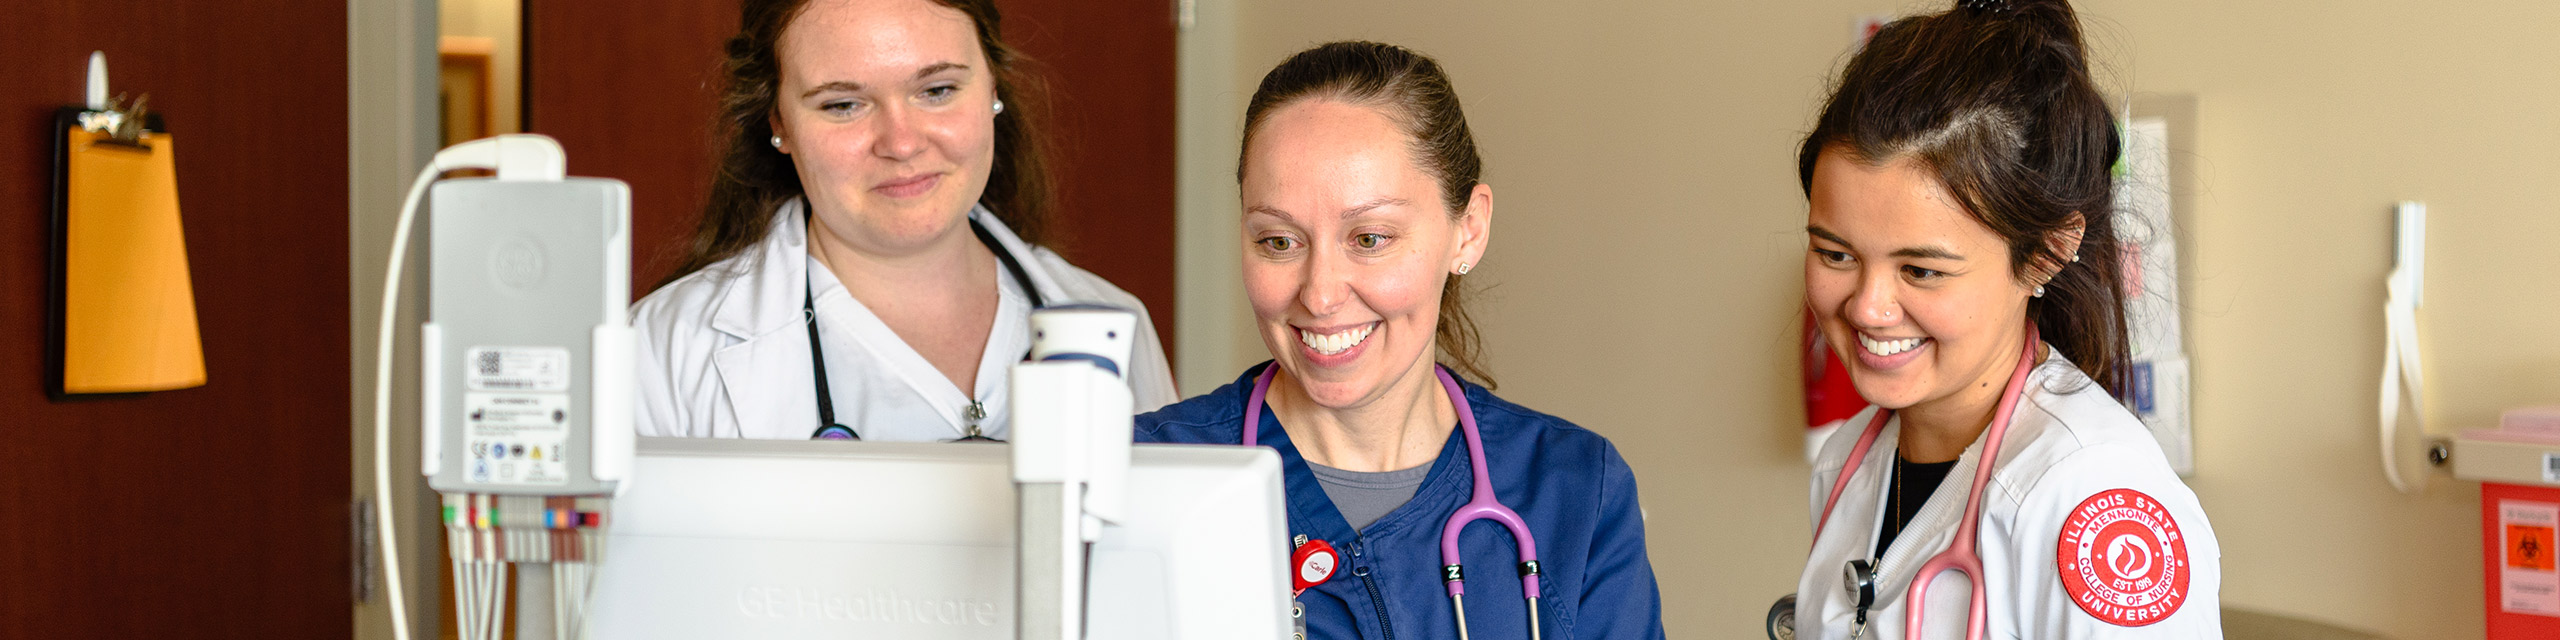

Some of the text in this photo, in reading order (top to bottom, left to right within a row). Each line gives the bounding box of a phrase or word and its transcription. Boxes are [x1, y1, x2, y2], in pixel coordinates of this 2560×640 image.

[2066, 493, 2178, 544] ILLINOIS STATE
[2089, 509, 2160, 534] MENNONITE
[2079, 555, 2174, 606] COLLEGE OF NURSING
[2113, 576, 2153, 592] EST 1919
[737, 586, 998, 627] GE Healthcare
[2081, 587, 2181, 621] UNIVERSITY
